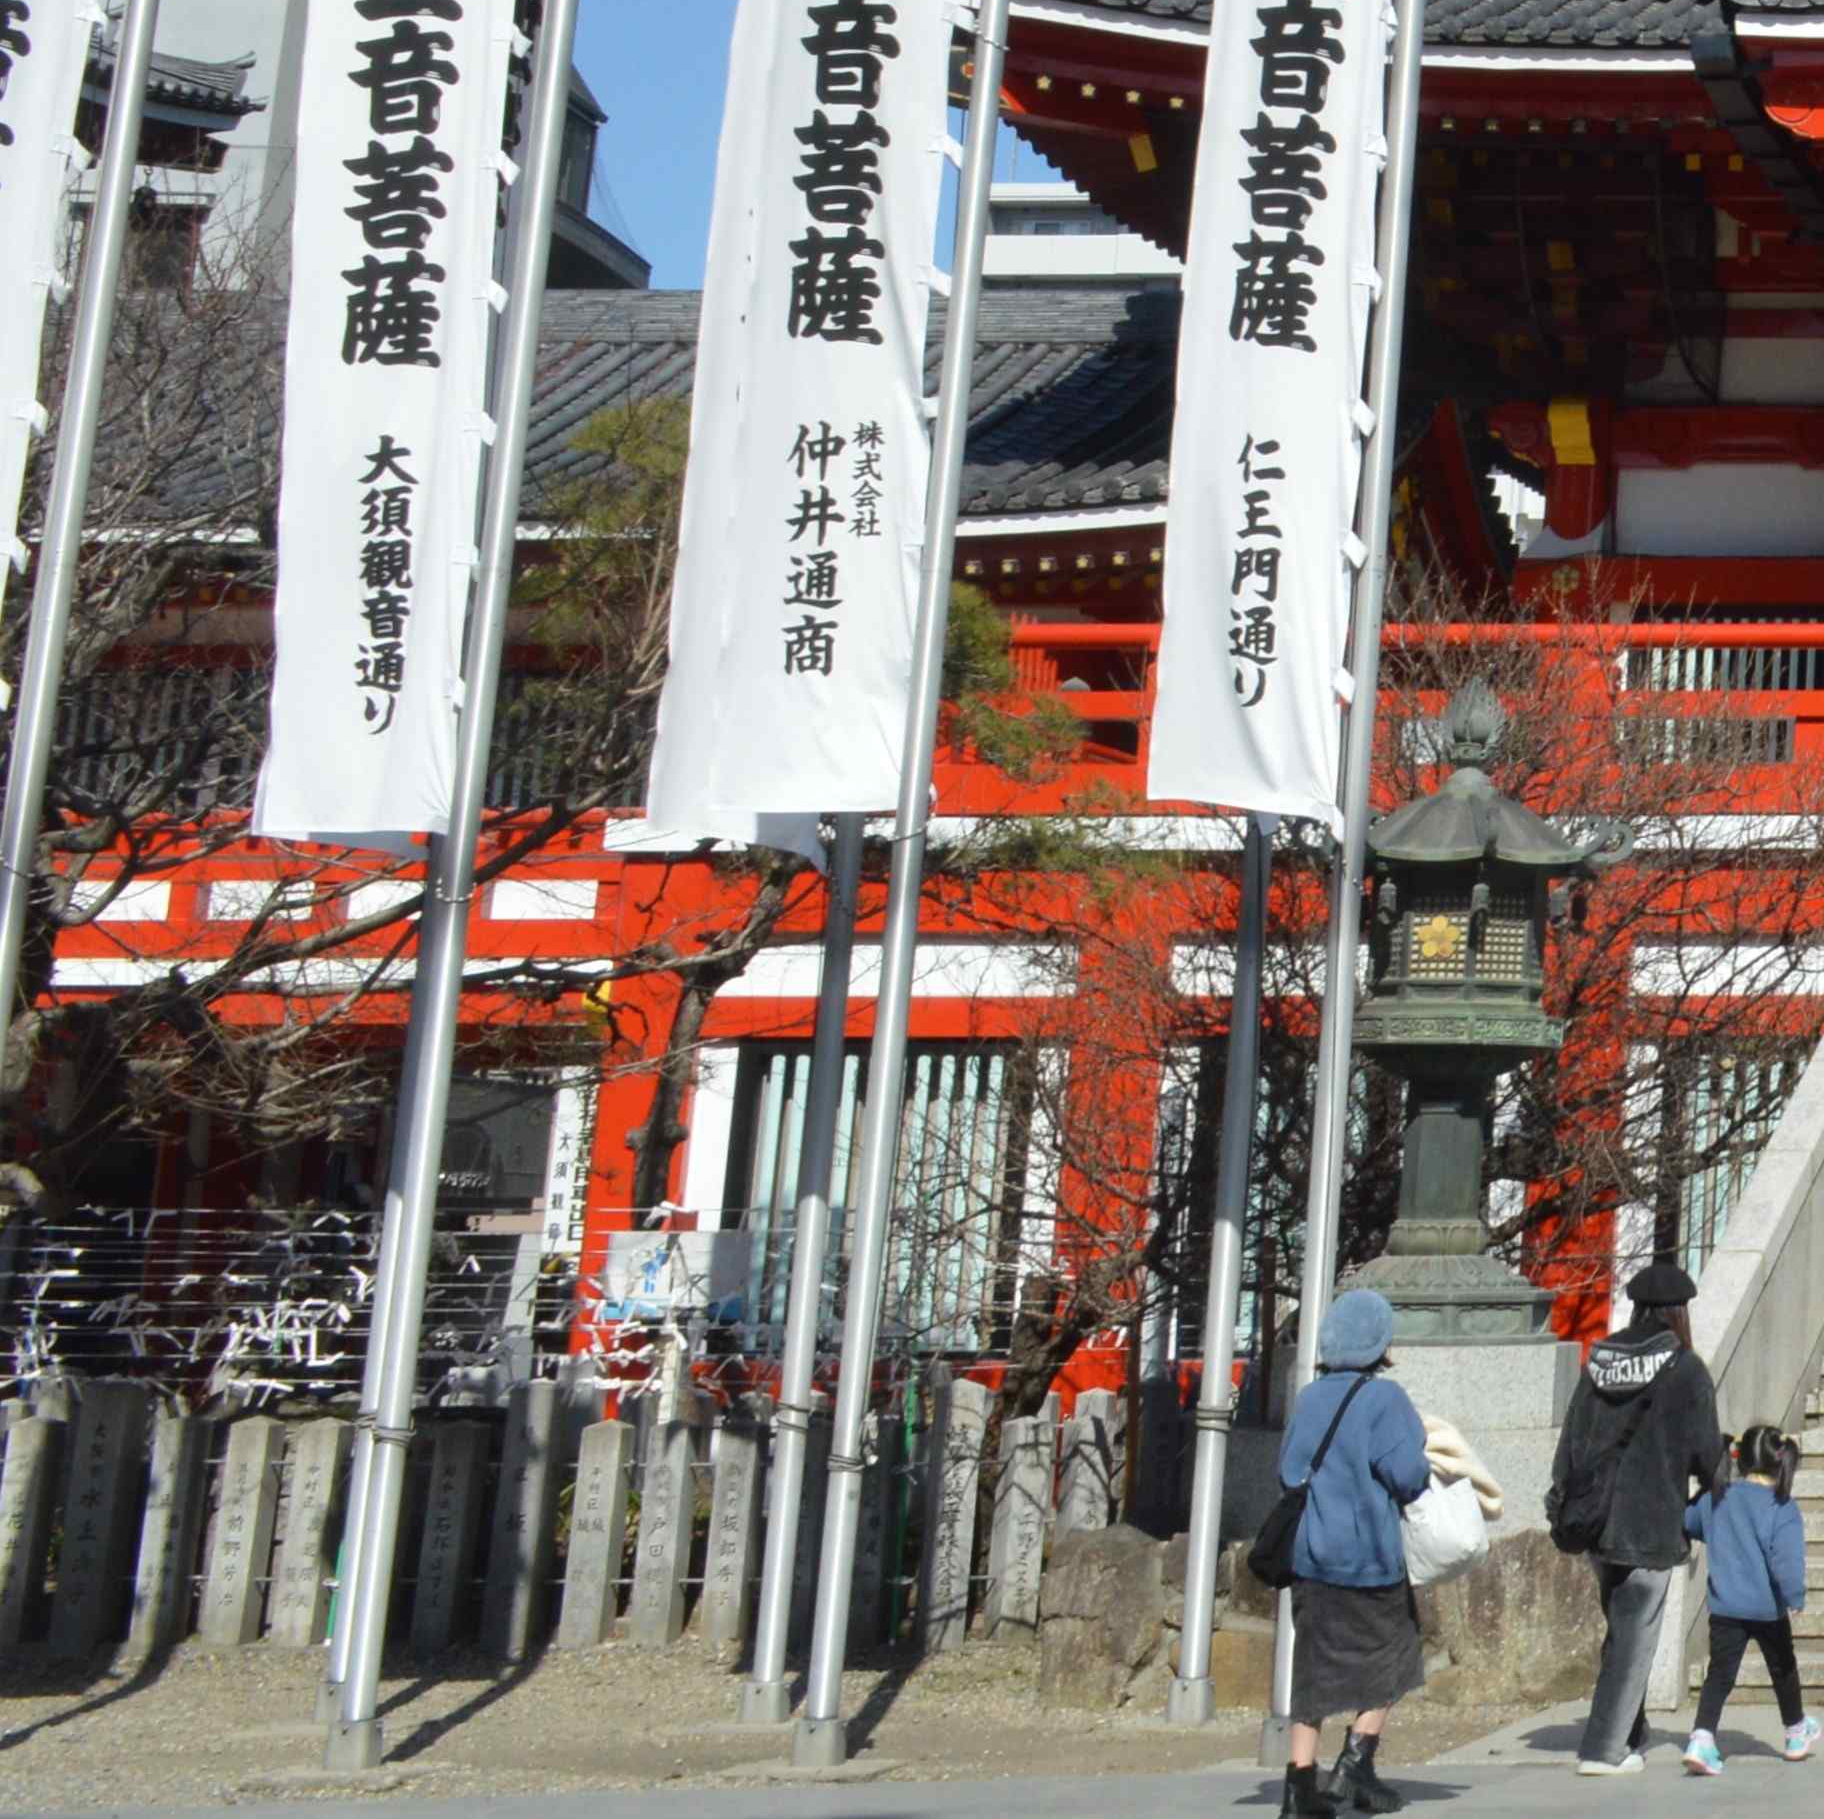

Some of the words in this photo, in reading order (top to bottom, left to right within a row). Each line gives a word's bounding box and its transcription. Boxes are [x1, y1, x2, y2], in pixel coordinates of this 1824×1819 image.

[355, 434, 419, 736] 大須観音通り
[783, 422, 846, 677] 仲井通商
[850, 421, 885, 539] 株式会社
[1228, 433, 1286, 709] 仁王門通り
